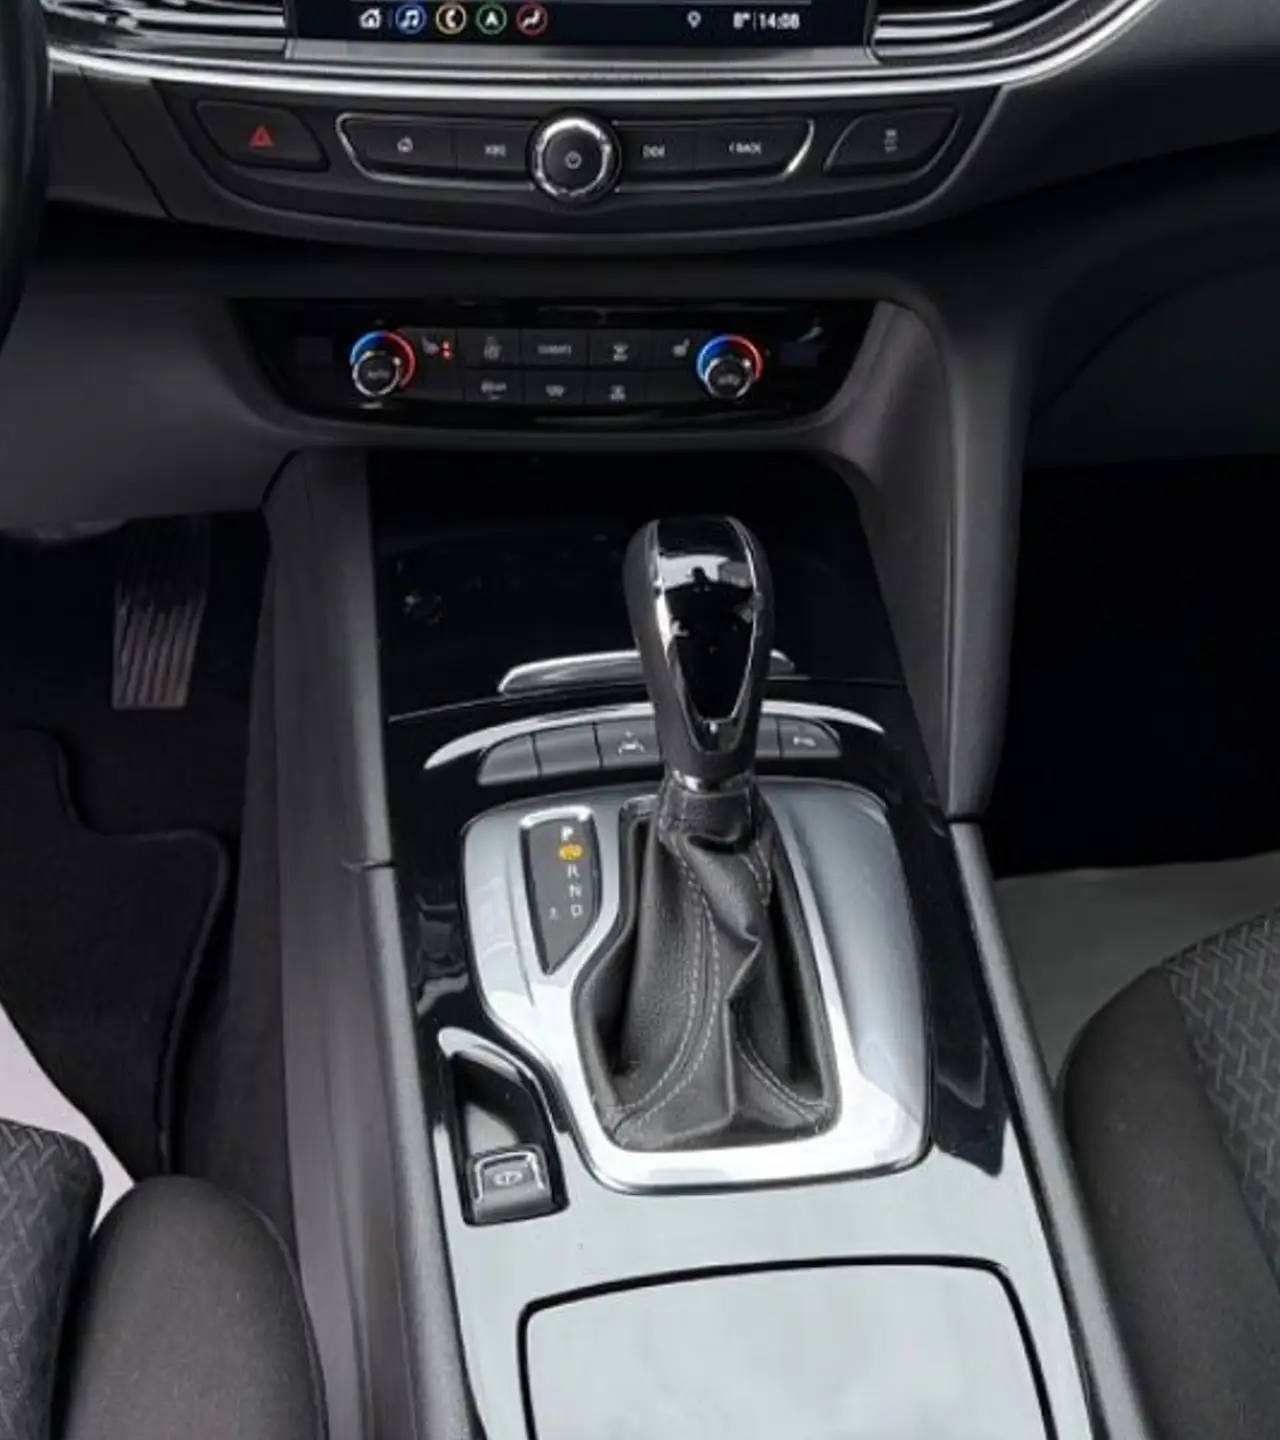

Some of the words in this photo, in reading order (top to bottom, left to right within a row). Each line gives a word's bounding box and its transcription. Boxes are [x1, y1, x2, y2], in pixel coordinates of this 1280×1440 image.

[561, 826, 574, 841] P
[568, 864, 580, 878] R
[569, 884, 583, 898] N
[570, 904, 584, 918] D
